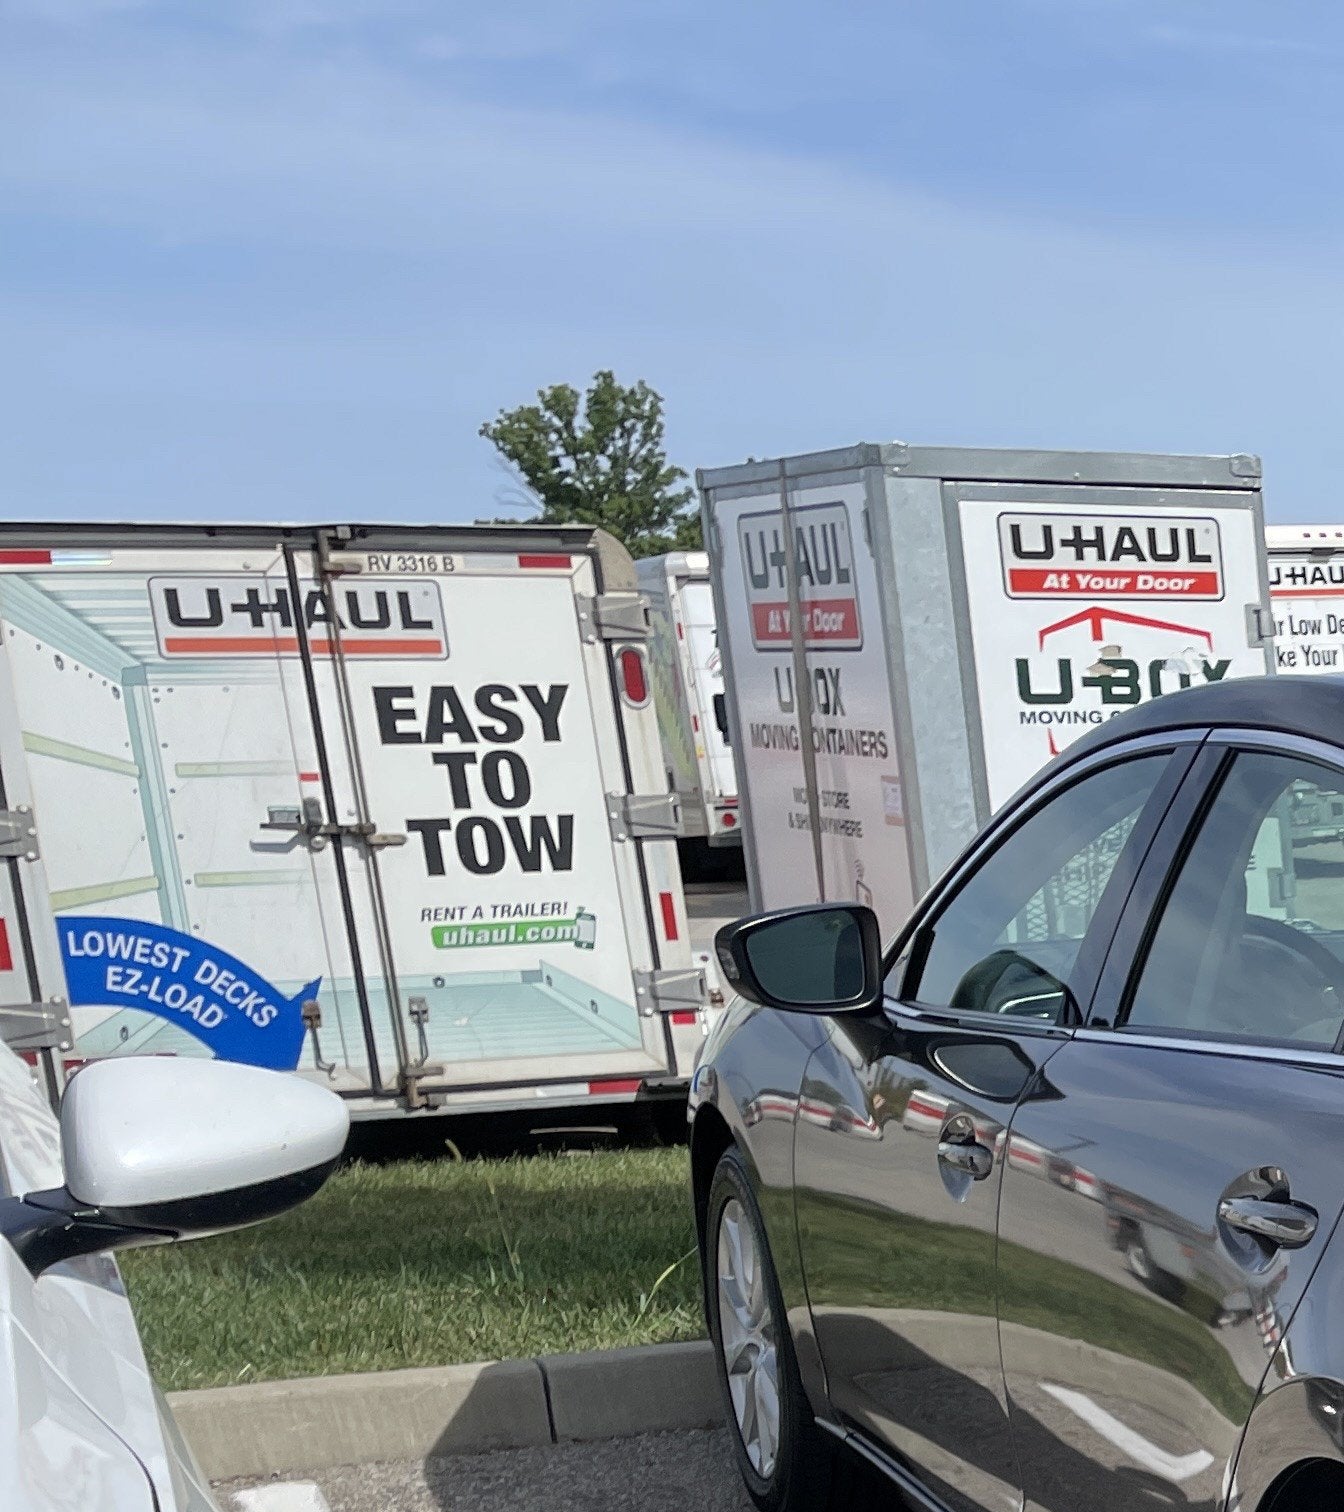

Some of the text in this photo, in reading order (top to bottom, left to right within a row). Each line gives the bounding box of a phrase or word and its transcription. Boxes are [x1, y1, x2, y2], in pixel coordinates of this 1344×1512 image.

[1010, 524, 1212, 563] U-HAUL
[368, 555, 456, 572] RV 3316 B
[1043, 573, 1197, 591] At Your Door
[163, 588, 434, 629] U-HAUL
[1289, 615, 1322, 636] Low
[1300, 641, 1338, 667] Your
[372, 683, 569, 745] EASY
[1020, 711, 1102, 725] MOVING
[811, 725, 888, 760] ONTAINERS
[432, 749, 532, 810] TO
[406, 814, 574, 878] TOW
[421, 899, 569, 923] RENT A TRAILER!
[441, 921, 580, 947] uhaul.com
[67, 930, 279, 1029] LOWEST DECKS
[106, 965, 226, 1029] EZ-LOAD
